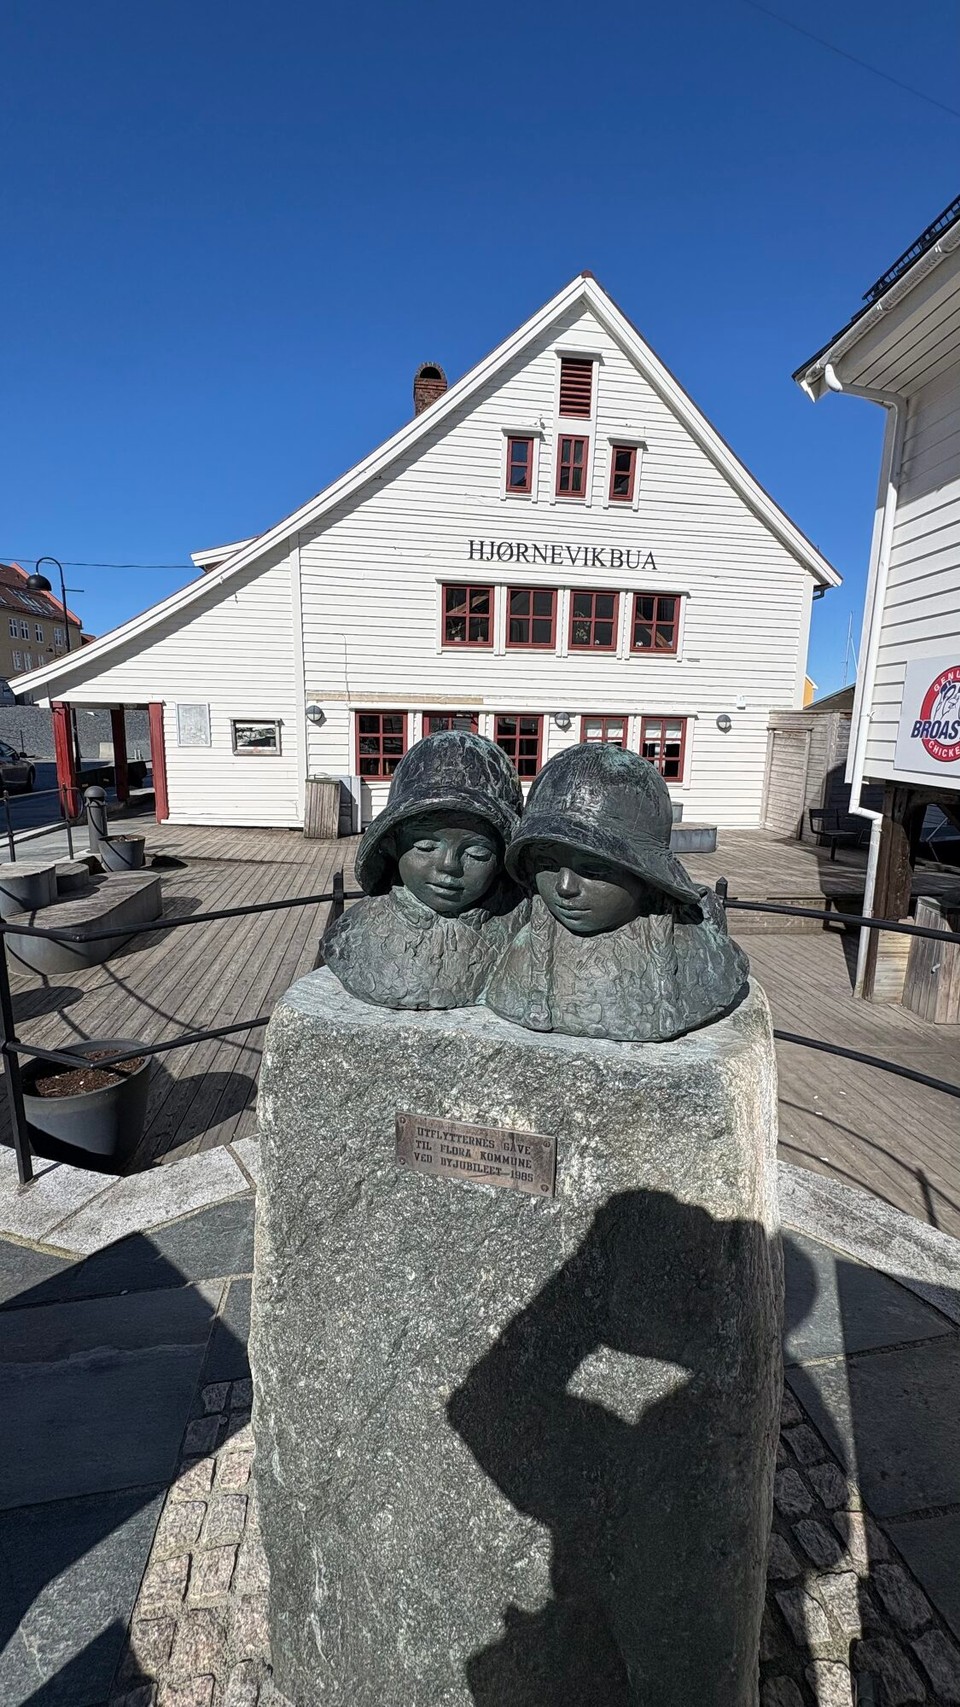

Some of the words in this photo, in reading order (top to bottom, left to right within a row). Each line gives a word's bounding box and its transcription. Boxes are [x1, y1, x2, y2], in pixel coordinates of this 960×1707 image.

[467, 540, 658, 570] HJØRNEVIKBUA
[911, 720, 960, 740] BROAS
[417, 1127, 495, 1149] UTFLYTTERNES
[414, 1152, 433, 1163] VED
[415, 1140, 432, 1151] TIL
[440, 1144, 472, 1158] FLORA
[480, 1150, 532, 1169] KOMMUNE
